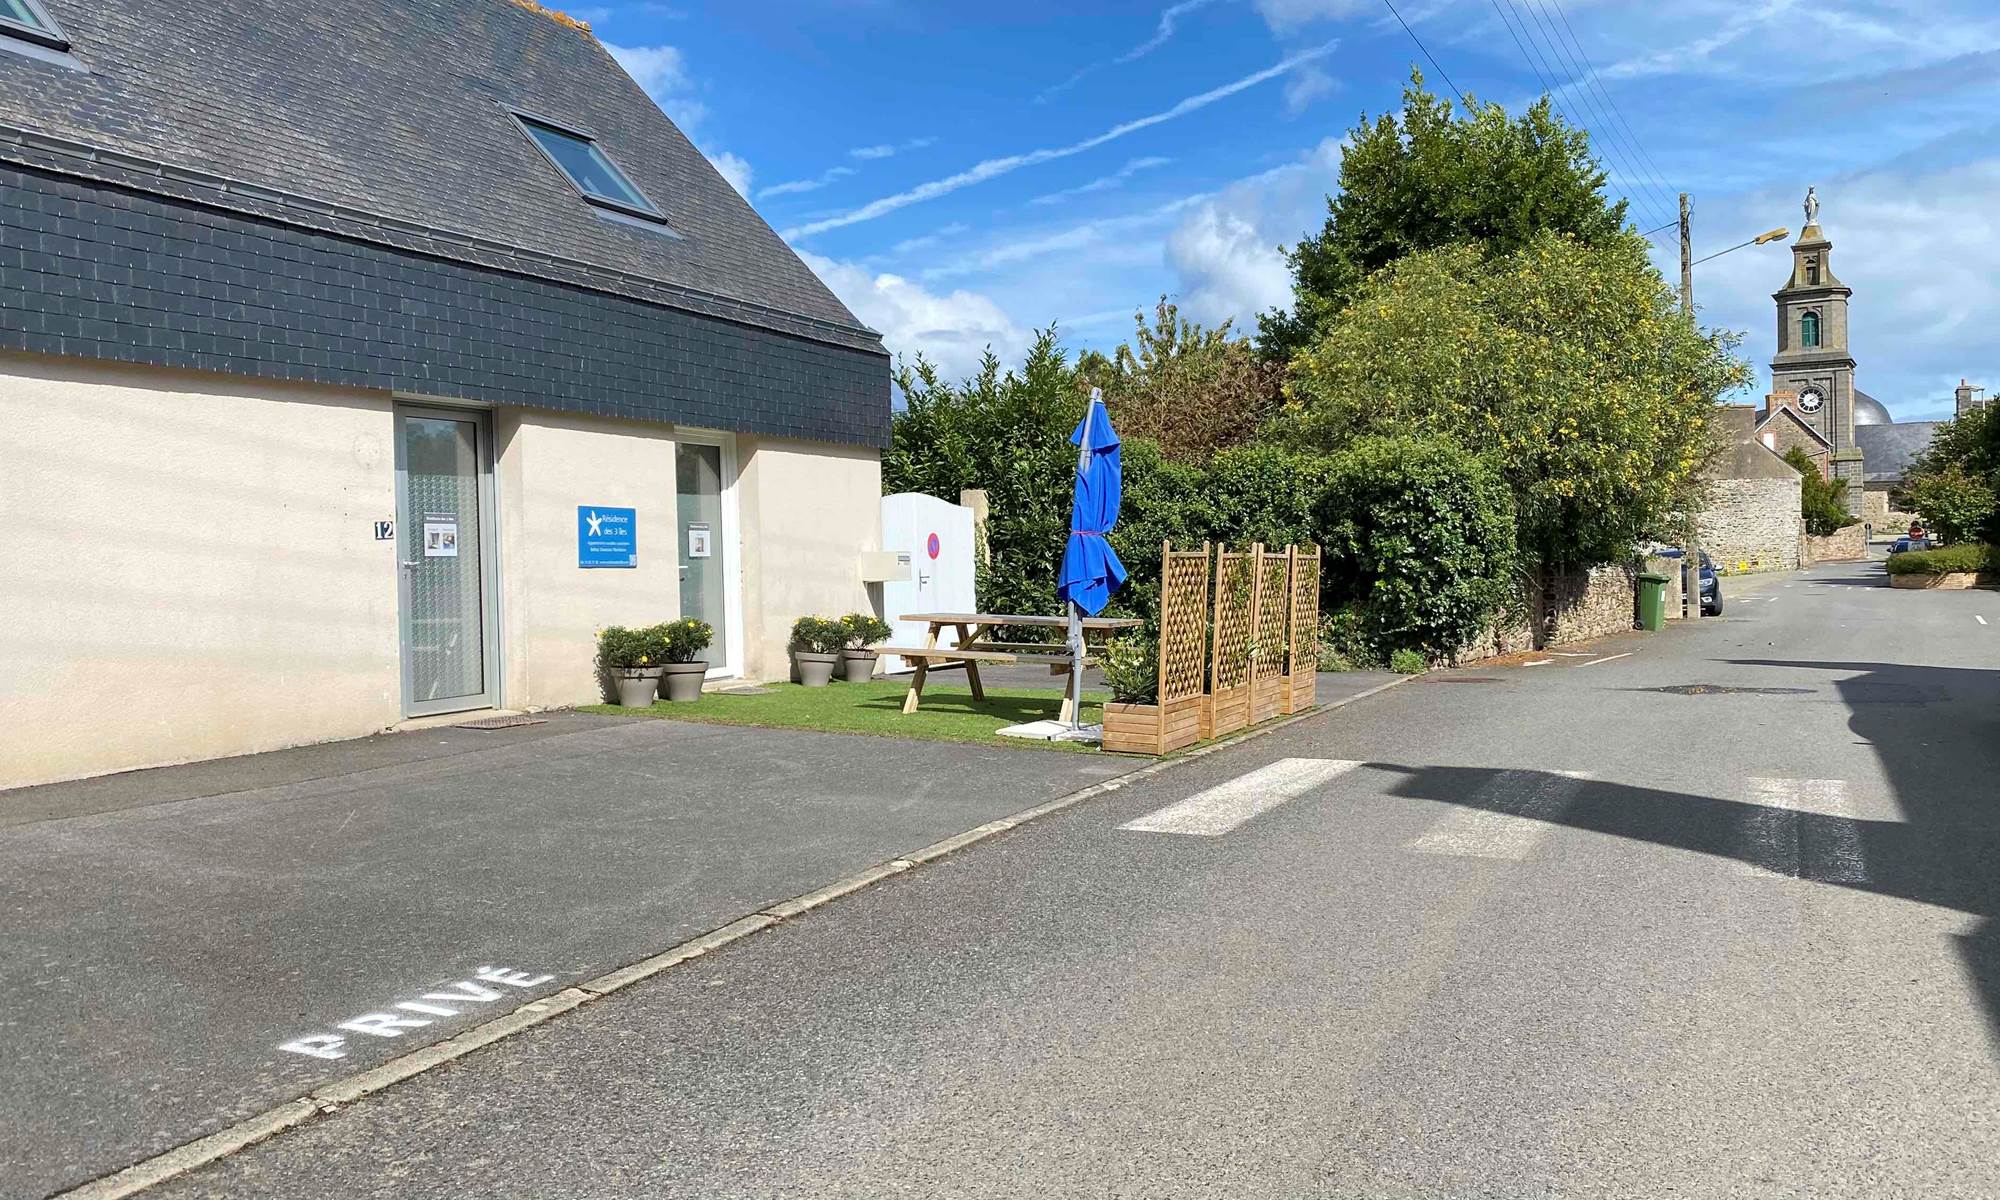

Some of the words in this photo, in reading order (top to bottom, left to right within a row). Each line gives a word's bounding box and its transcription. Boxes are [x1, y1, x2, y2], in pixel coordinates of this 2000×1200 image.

[602, 514, 628, 523] Résidence
[376, 521, 394, 539] 12
[604, 527, 613, 535] des
